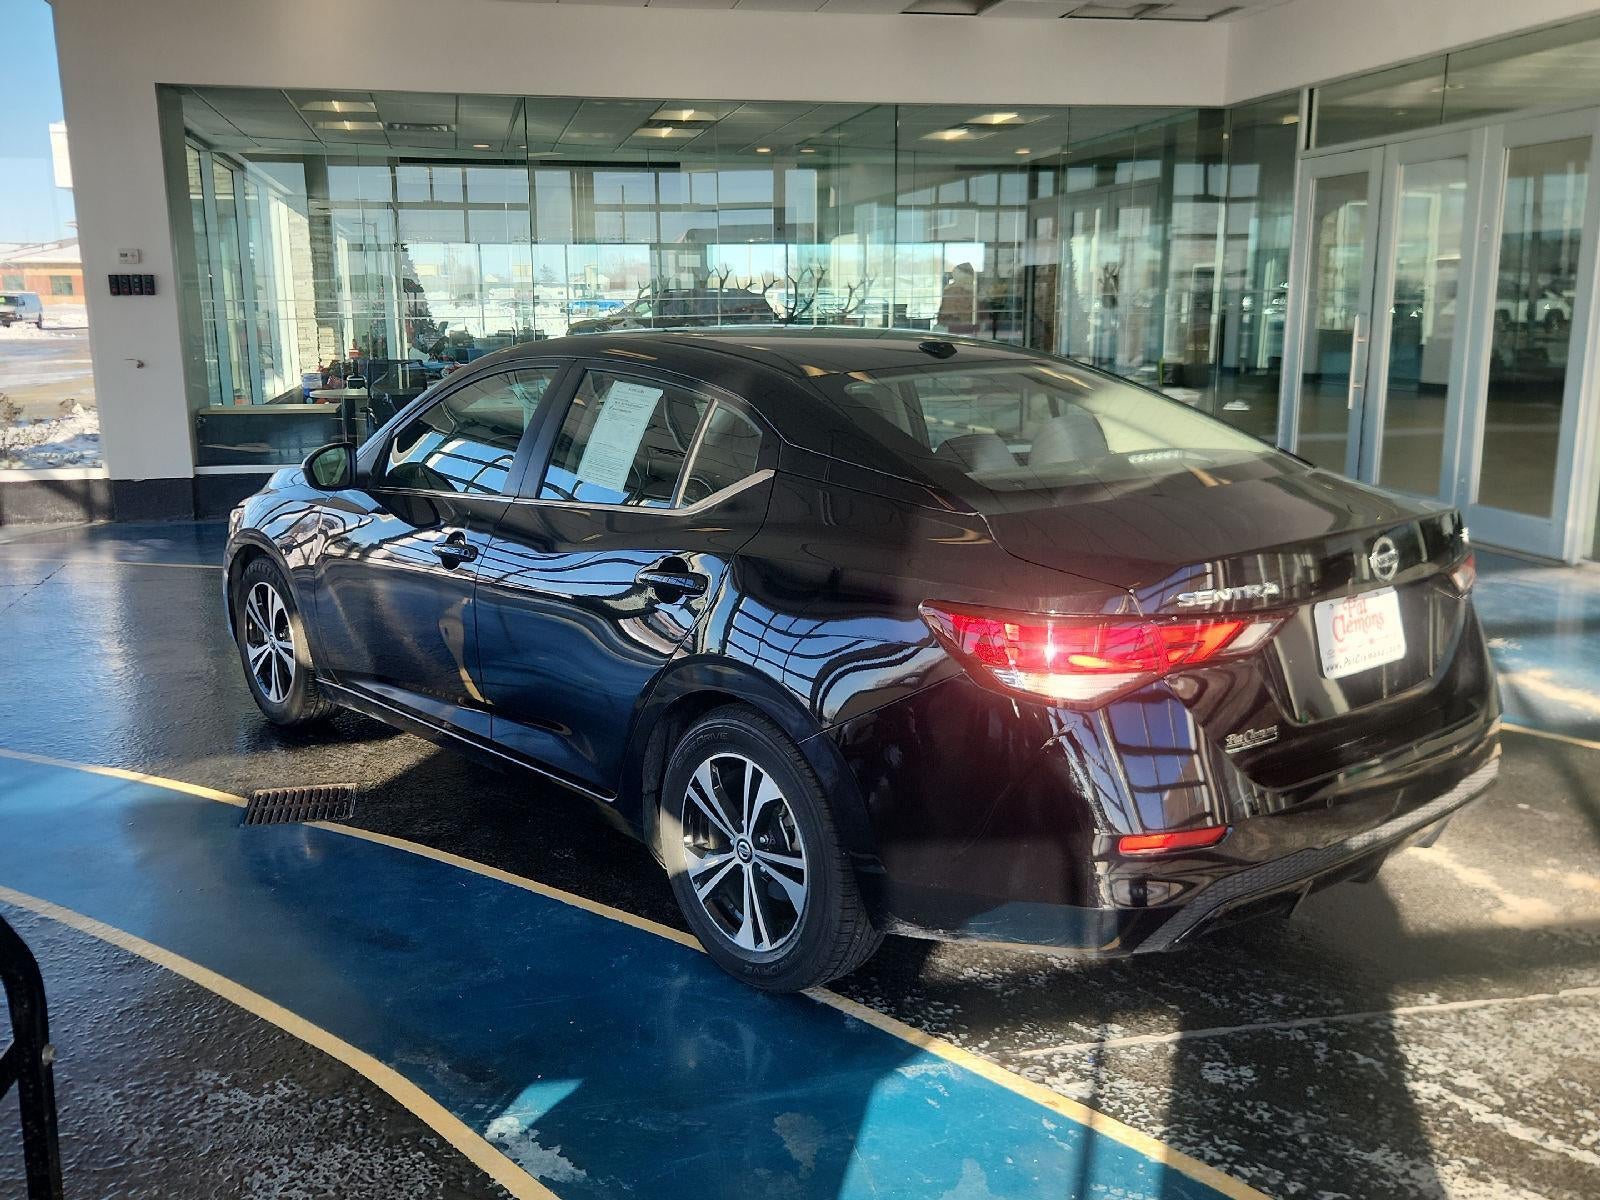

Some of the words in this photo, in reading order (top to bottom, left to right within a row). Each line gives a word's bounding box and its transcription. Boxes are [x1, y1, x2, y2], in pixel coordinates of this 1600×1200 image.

[1177, 582, 1280, 608] SENTRA
[1343, 596, 1368, 618] Pat
[1332, 611, 1385, 643] Clemons
